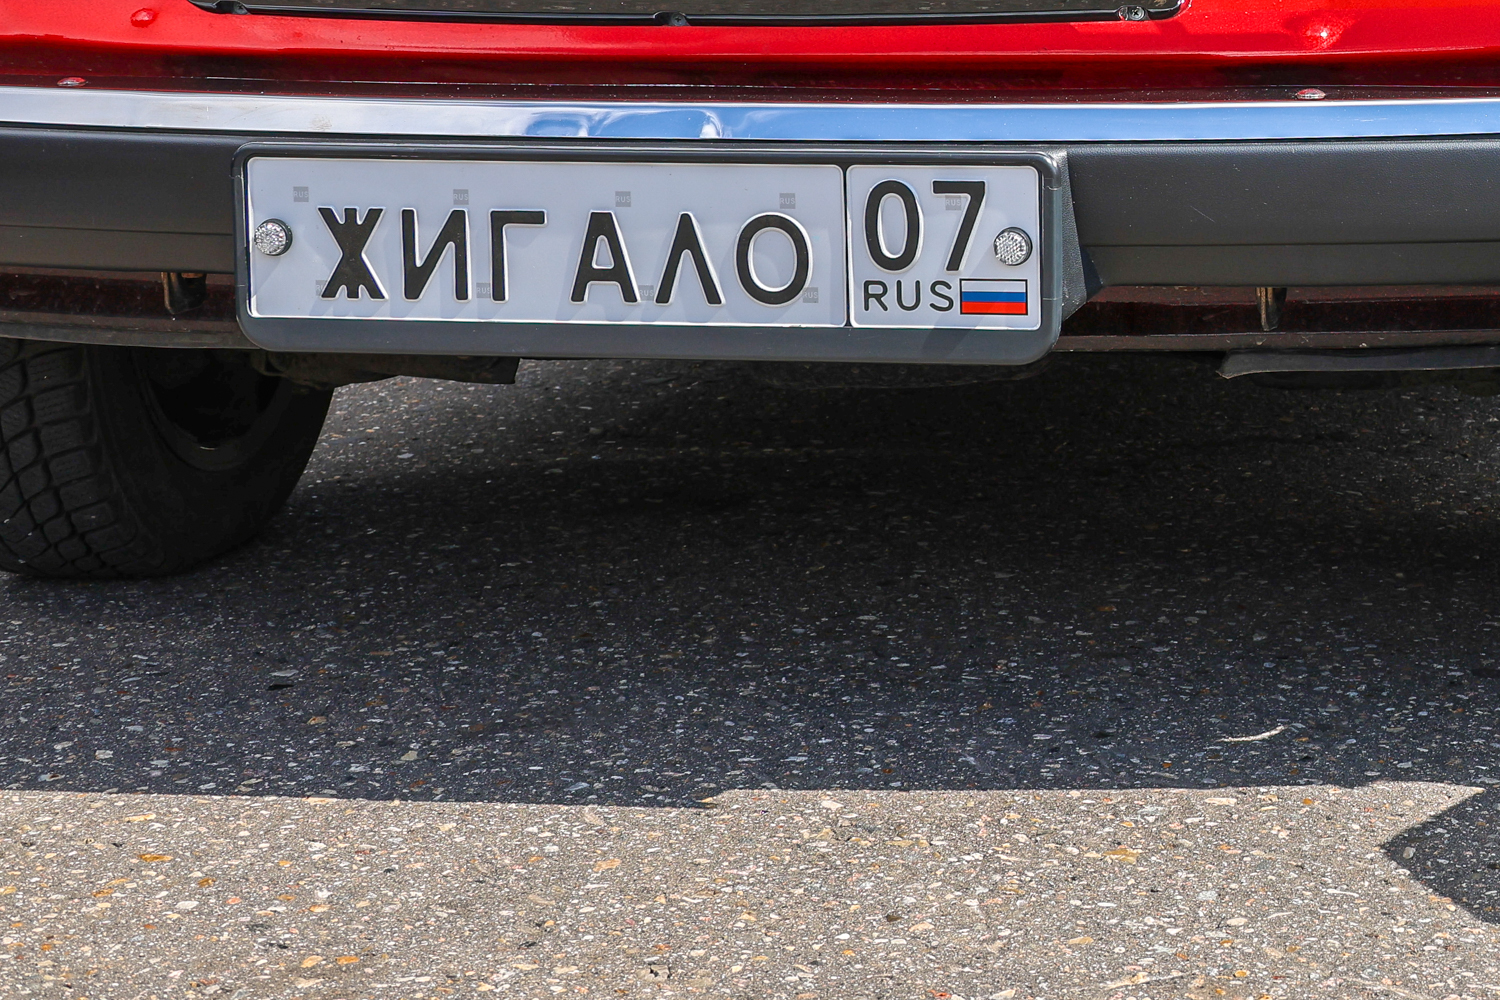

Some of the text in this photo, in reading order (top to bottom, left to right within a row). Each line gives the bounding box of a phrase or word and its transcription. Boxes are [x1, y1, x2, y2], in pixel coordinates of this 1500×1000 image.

[317, 207, 810, 305] ЖИГАЛО
[864, 180, 986, 272] 07
[863, 279, 954, 312] RUS
